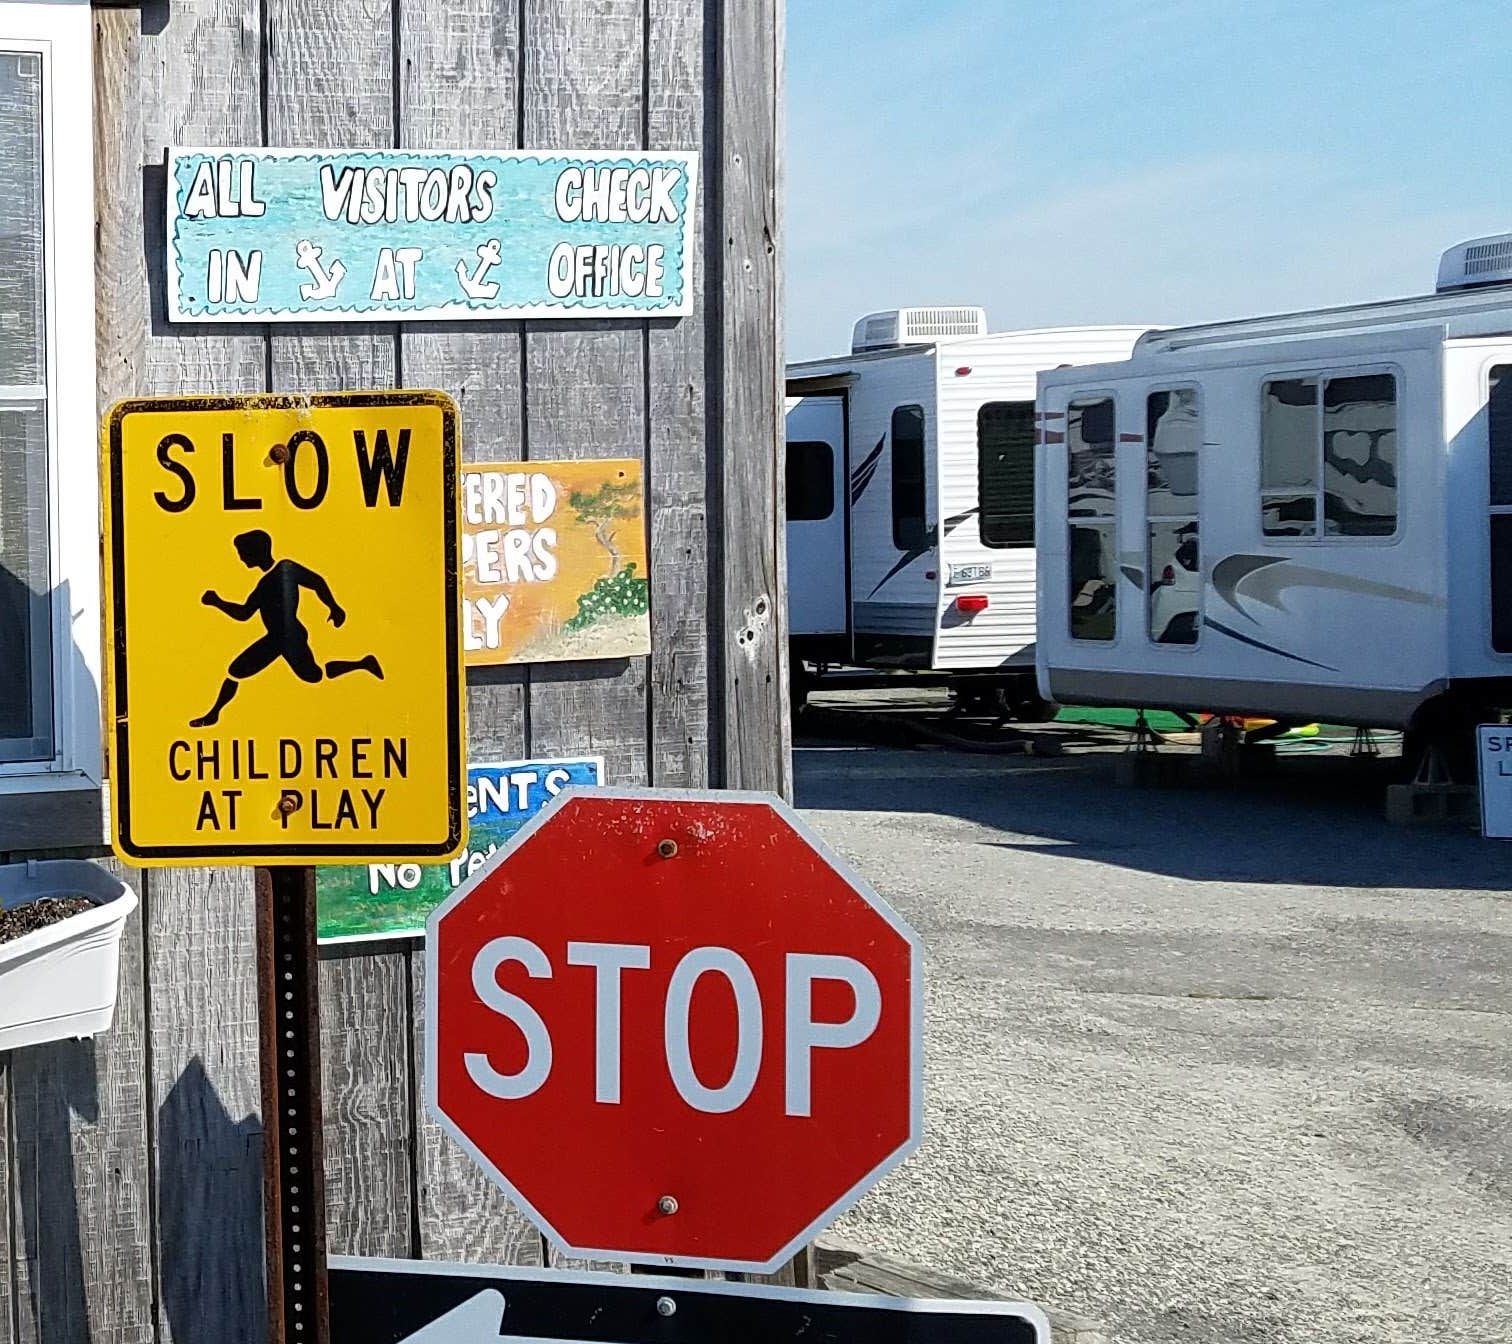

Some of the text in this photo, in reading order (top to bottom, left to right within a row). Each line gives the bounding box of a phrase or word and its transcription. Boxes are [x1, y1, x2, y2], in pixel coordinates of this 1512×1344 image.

[183, 159, 682, 225] ALL VISITORS CHECK
[206, 241, 665, 304] IN AT OFFICE
[153, 428, 412, 514] SLOW
[462, 472, 557, 526] ERED
[168, 737, 408, 782] CHILDREN
[195, 788, 386, 832] AT PLAY
[463, 935, 883, 1118] STOP
